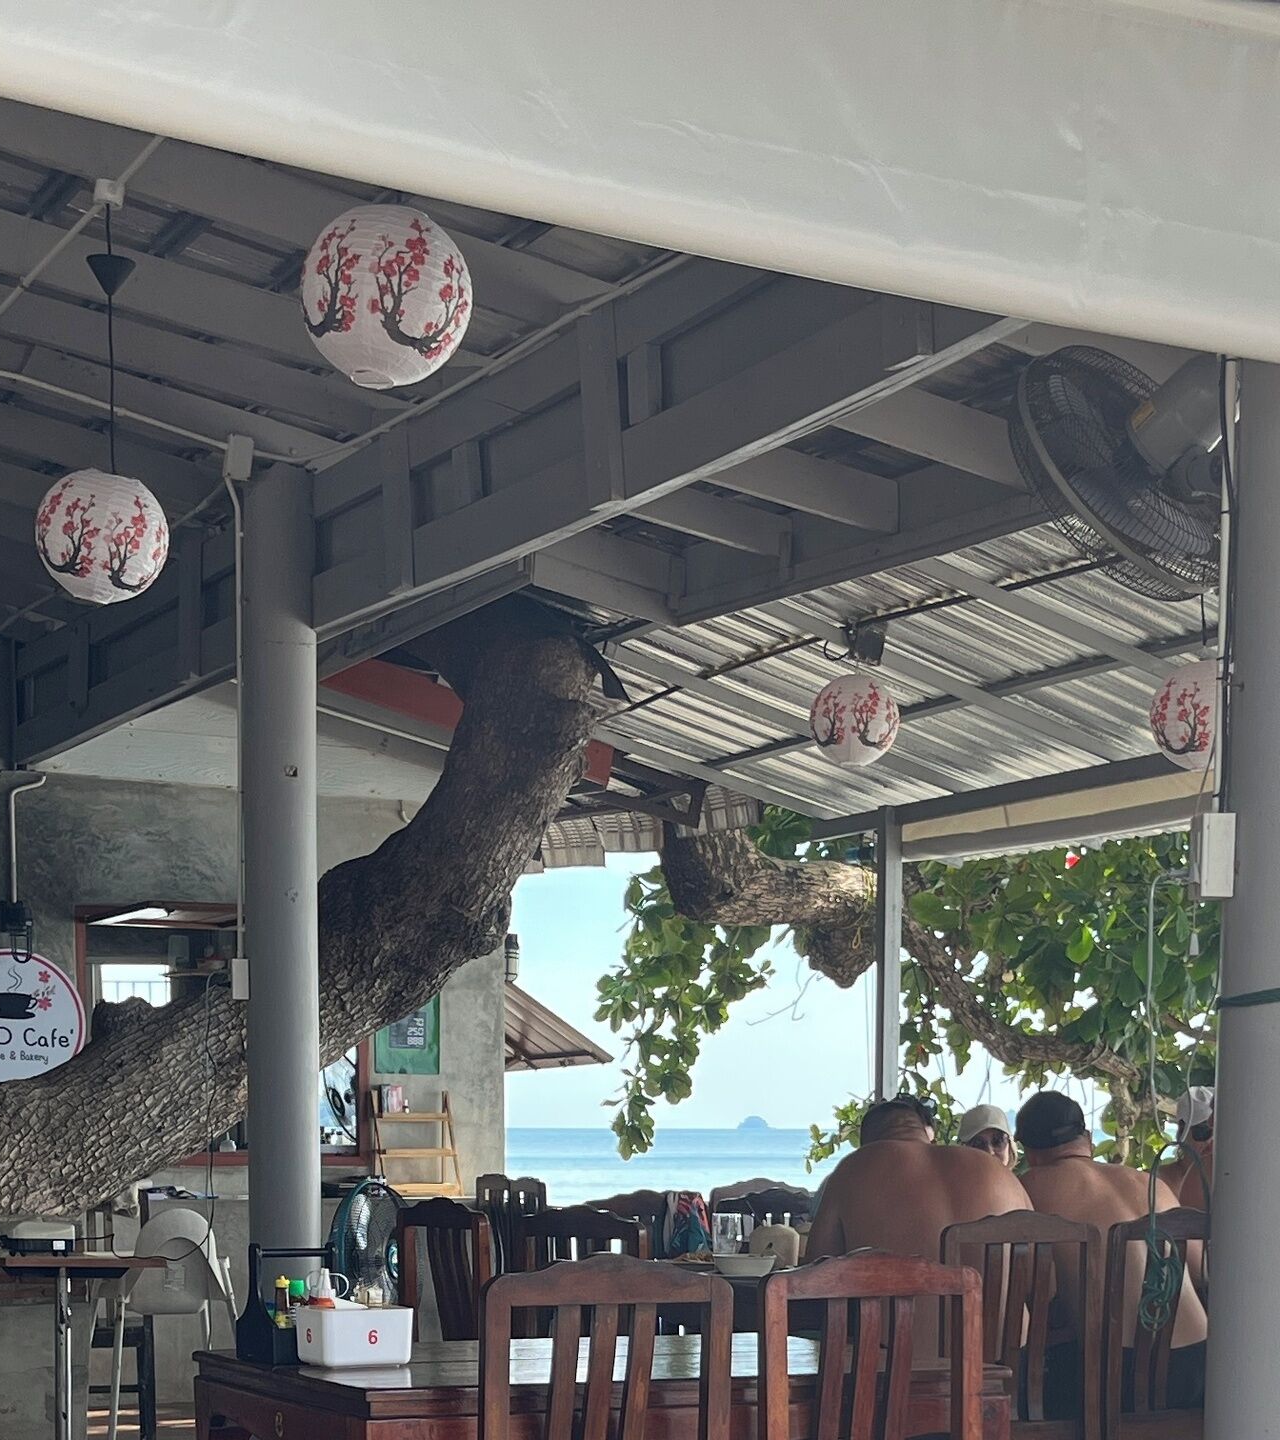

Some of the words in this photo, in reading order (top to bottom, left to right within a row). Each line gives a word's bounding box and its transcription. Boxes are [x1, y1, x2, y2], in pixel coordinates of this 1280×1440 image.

[9, 1050, 17, 1060] &
[20, 1050, 49, 1065] Bakery
[306, 1328, 313, 1344] 6
[368, 1329, 379, 1345] 6
